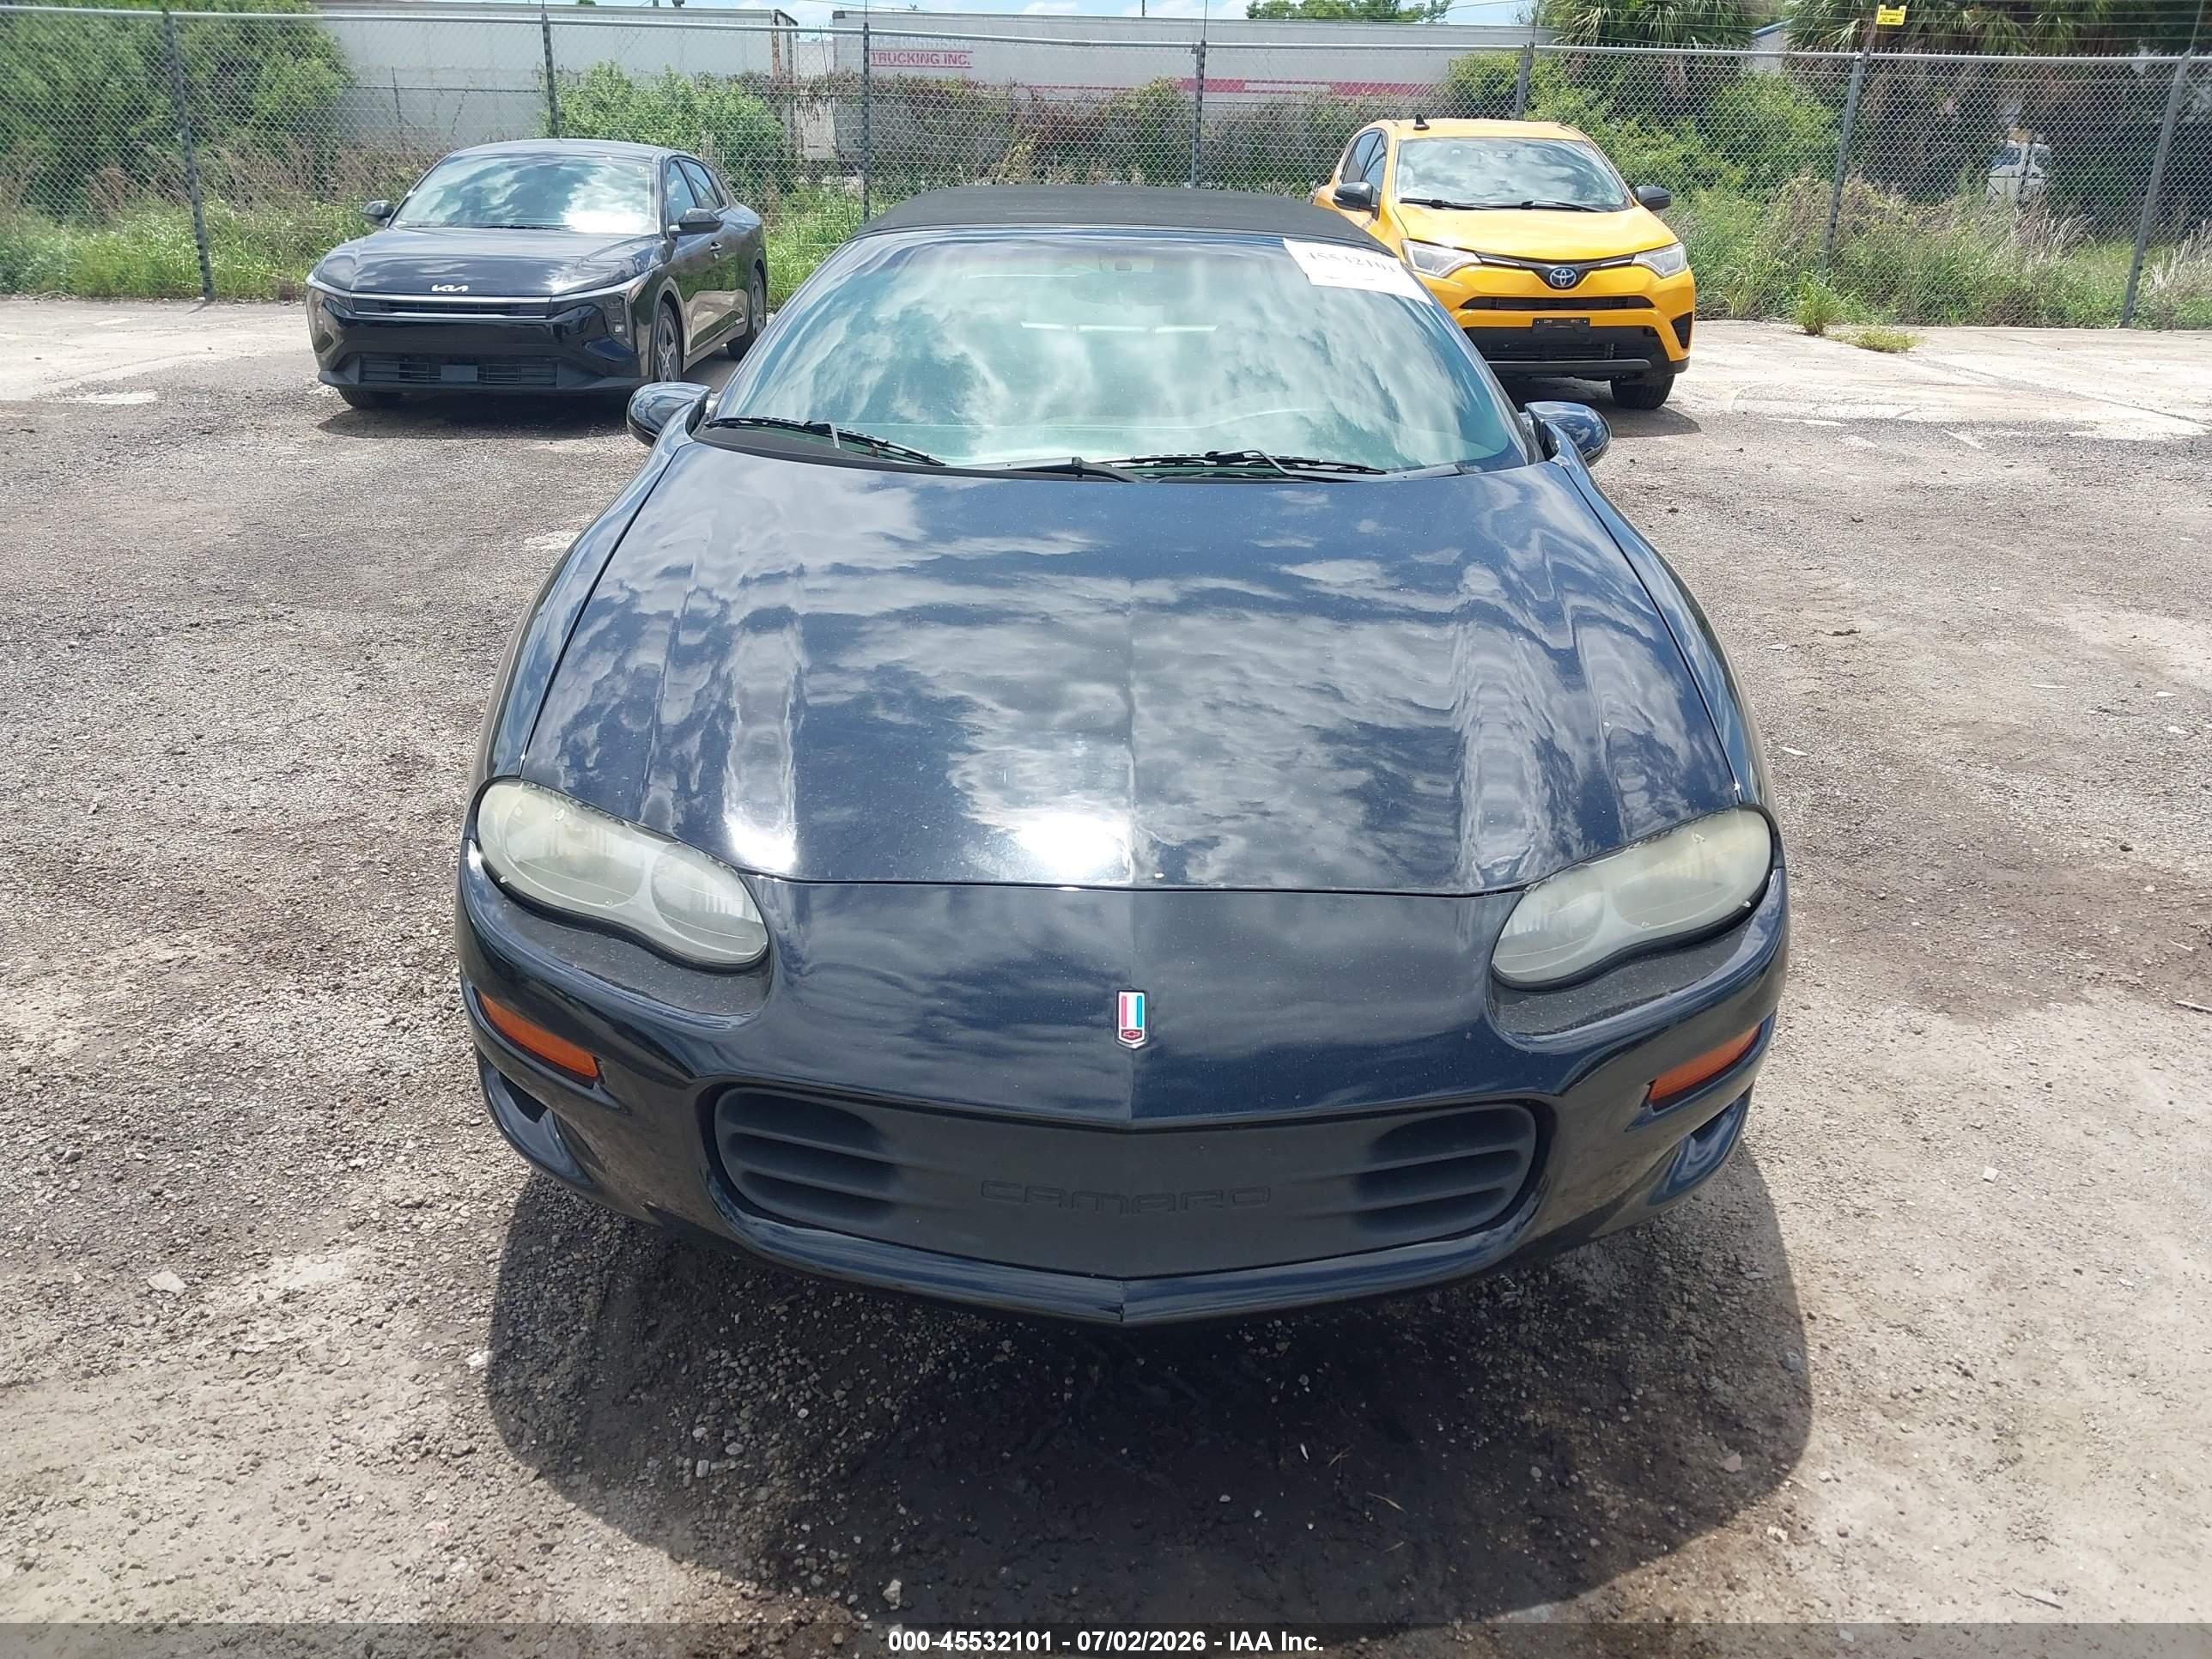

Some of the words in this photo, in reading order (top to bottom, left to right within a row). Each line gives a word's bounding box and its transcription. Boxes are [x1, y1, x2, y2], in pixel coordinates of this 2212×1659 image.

[870, 52, 939, 64] TRUCKING
[944, 53, 971, 65] INC.
[981, 1179, 1272, 1215] CAMARO
